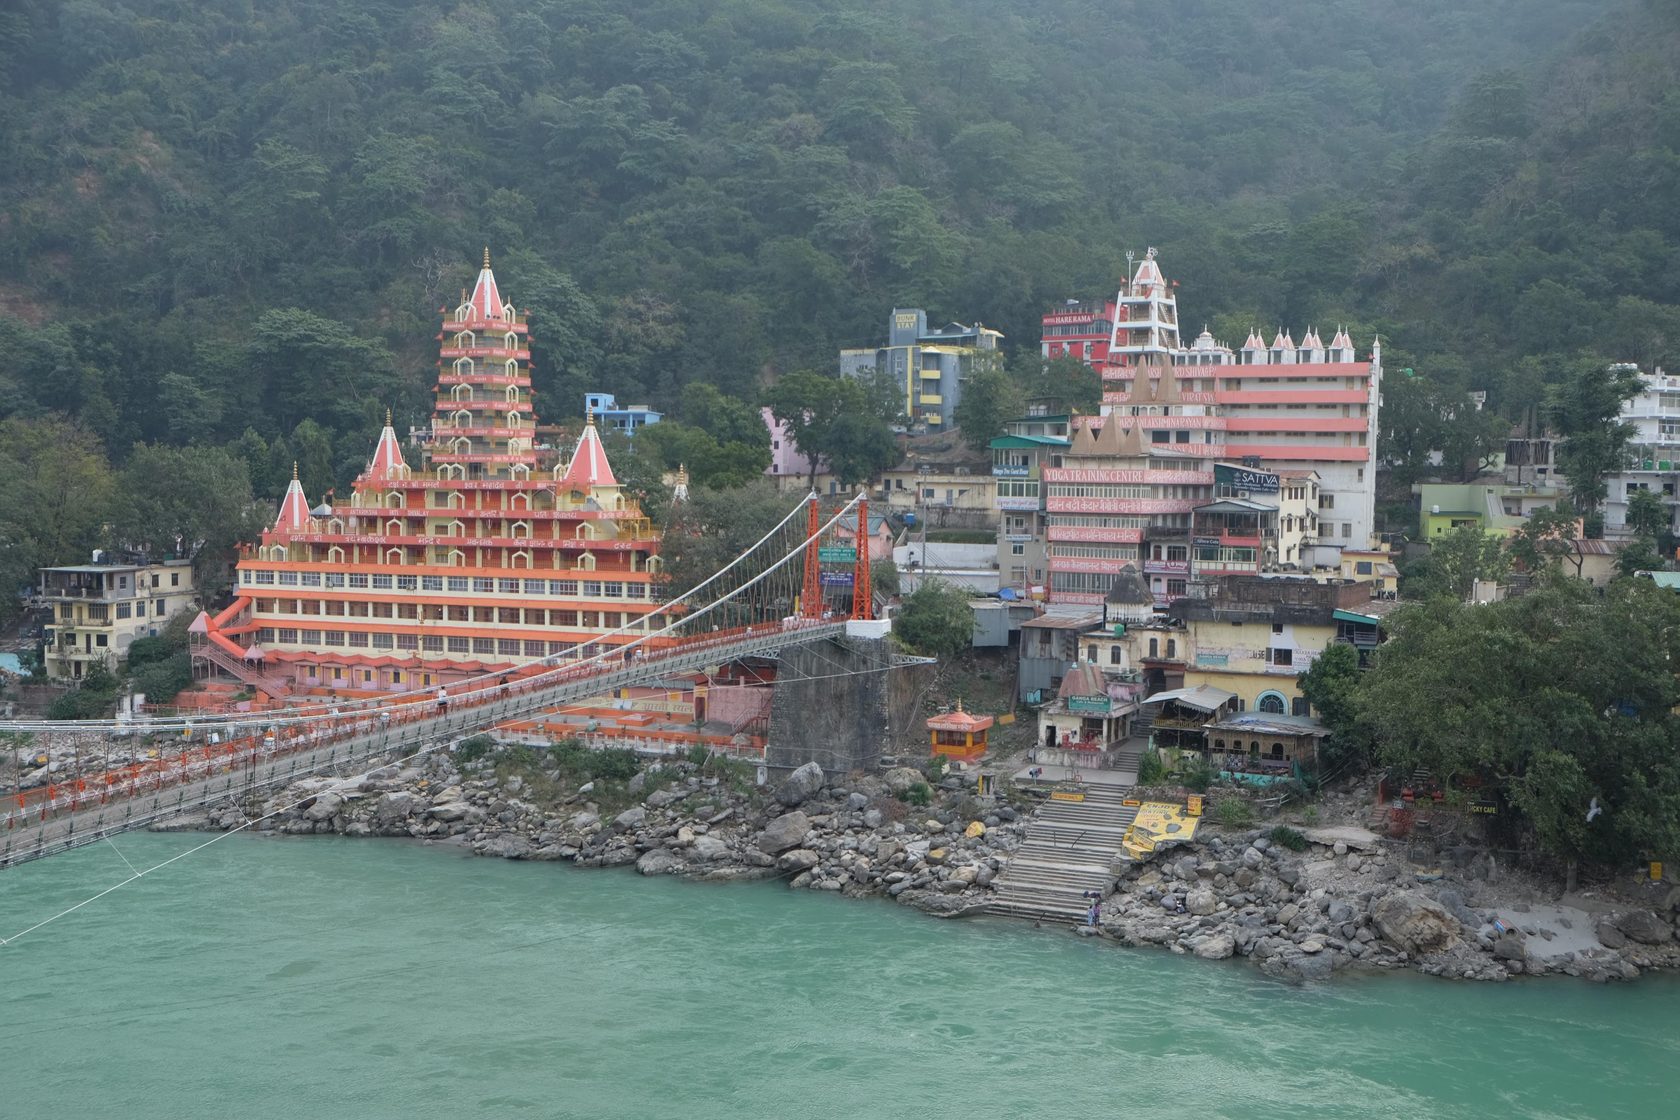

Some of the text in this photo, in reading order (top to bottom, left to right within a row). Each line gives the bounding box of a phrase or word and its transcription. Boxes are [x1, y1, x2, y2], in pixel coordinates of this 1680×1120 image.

[1056, 315, 1073, 324] HARE
[1073, 315, 1091, 323] RAMA
[1046, 468, 1069, 480] YOGA
[1071, 469, 1109, 482] TRAINING
[1110, 470, 1143, 482] CENTRE
[1242, 472, 1278, 485] SATTVA
[1484, 806, 1497, 814] CAFE
